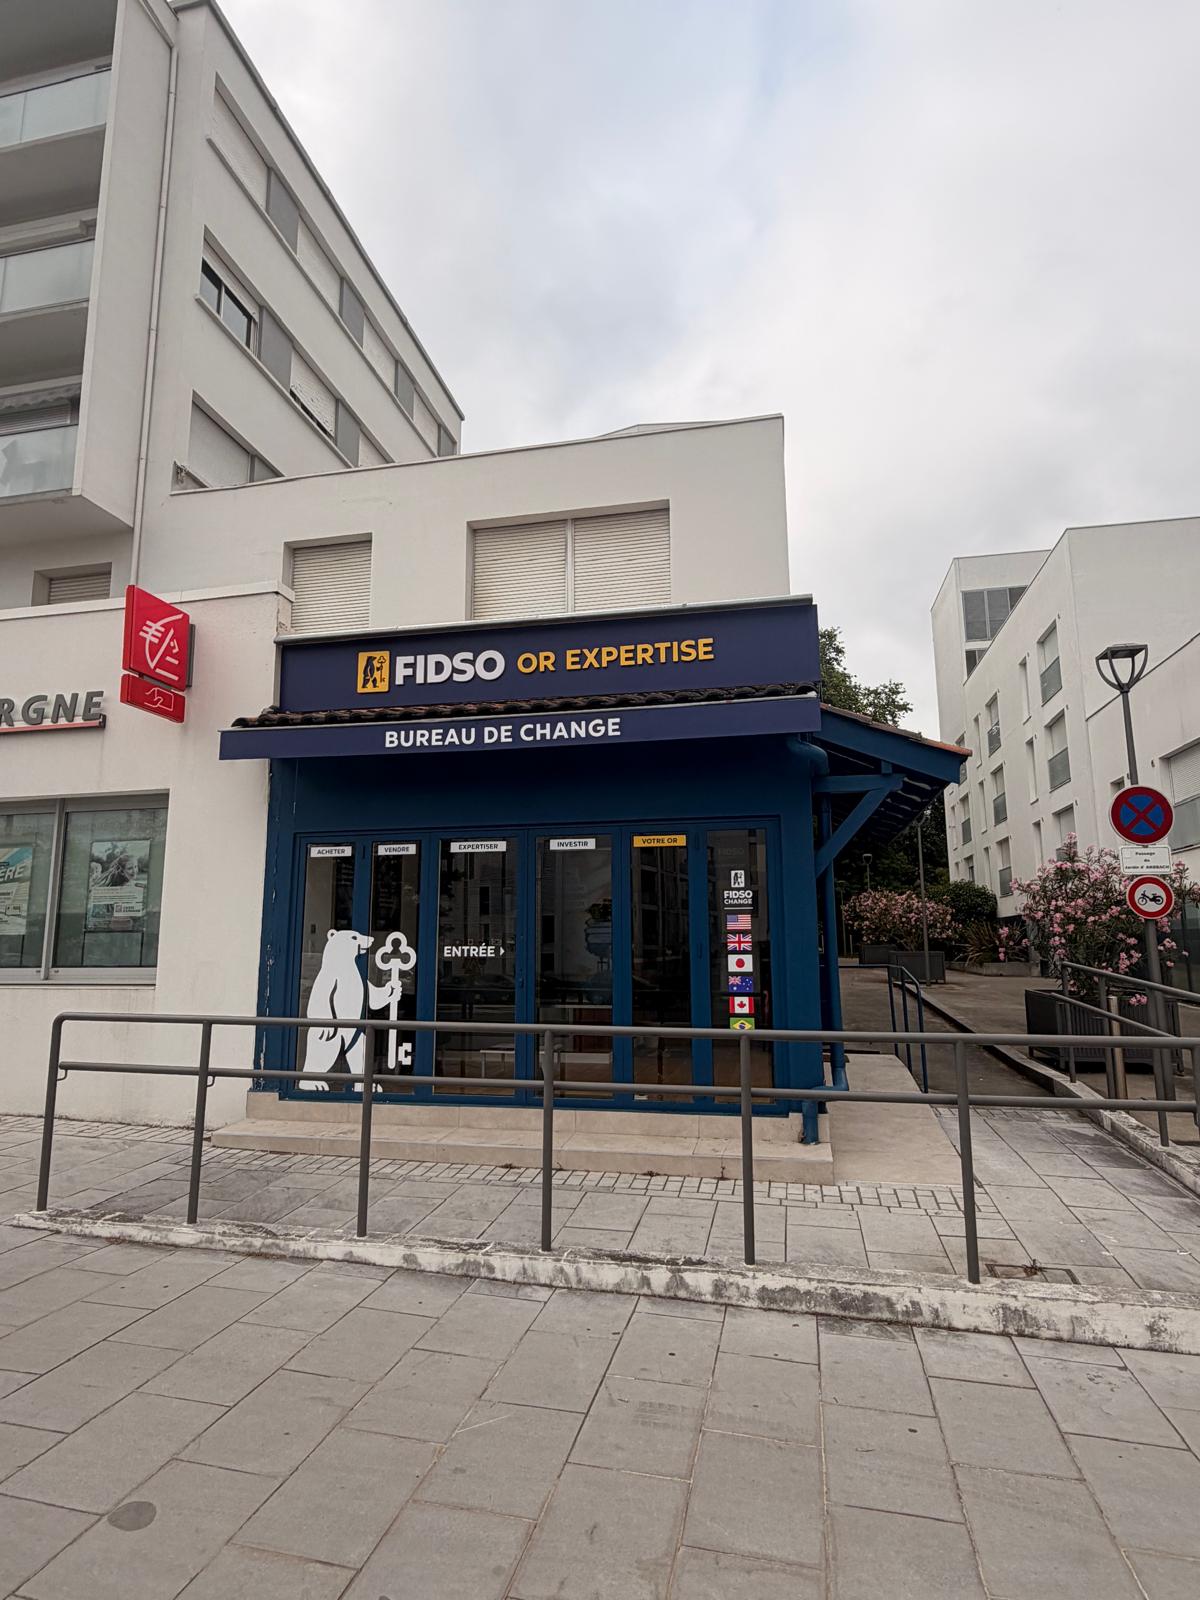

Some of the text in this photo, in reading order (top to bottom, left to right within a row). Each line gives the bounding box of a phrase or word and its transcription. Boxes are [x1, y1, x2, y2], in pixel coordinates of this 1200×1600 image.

[517, 637, 715, 674] OR EXPERTISE
[395, 650, 505, 686] FIDSO
[385, 717, 621, 748] BUREAU DE CHANGE
[557, 840, 589, 848] INVESTIR
[723, 890, 753, 899] FIDSO
[444, 943, 495, 957] ENTRÉE
